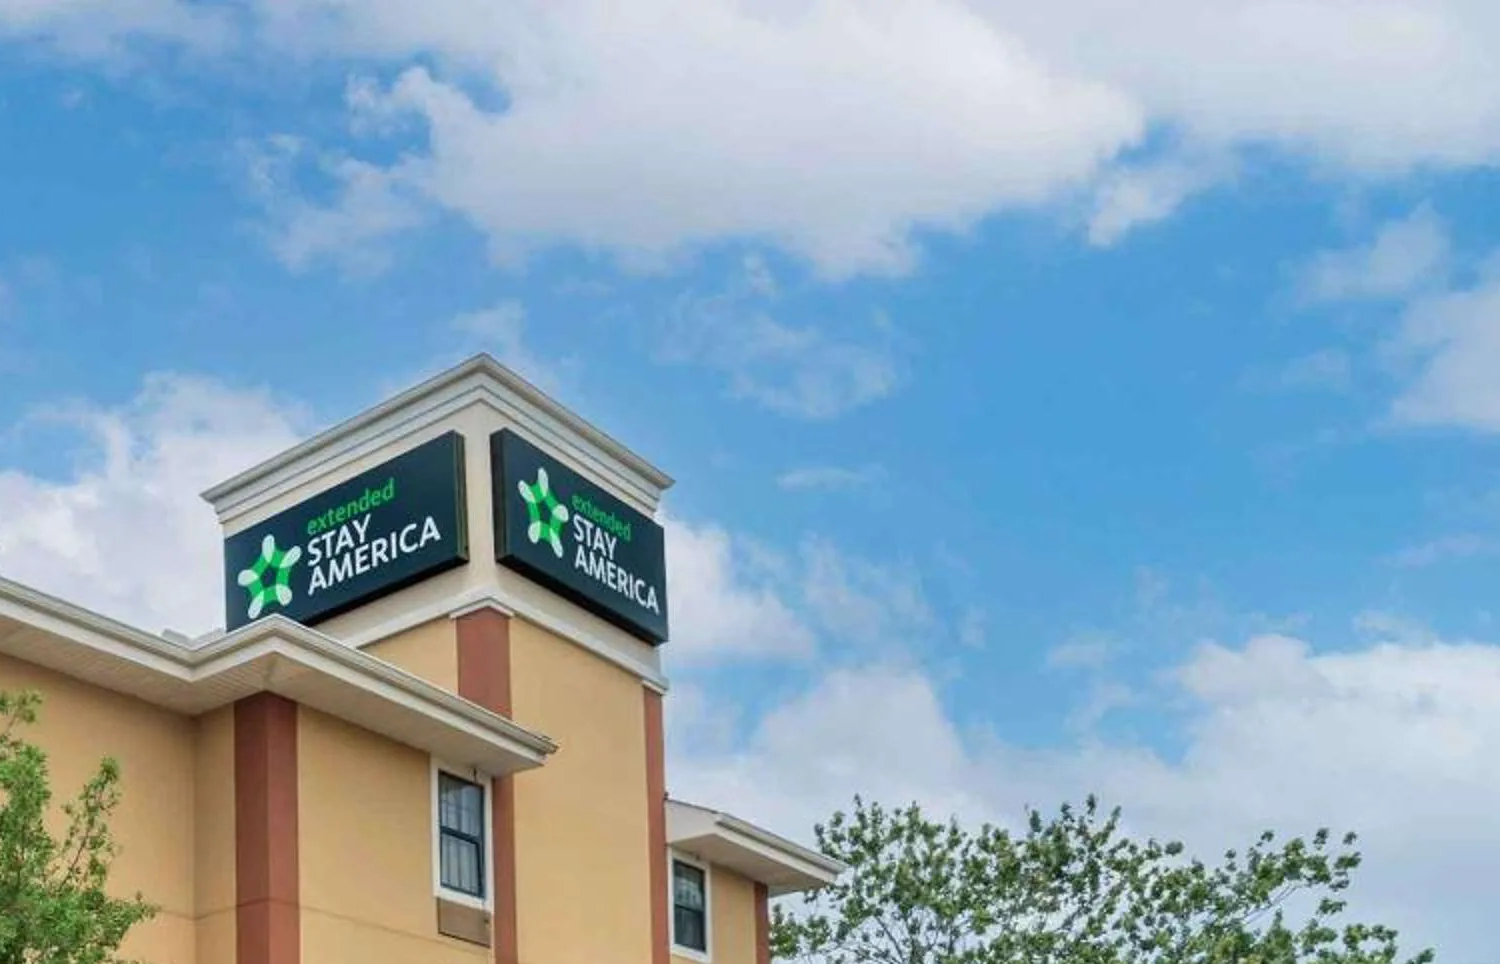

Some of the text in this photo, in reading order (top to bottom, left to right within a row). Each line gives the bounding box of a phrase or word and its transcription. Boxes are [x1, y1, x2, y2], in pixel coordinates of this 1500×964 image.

[307, 477, 395, 535] extended
[572, 495, 631, 541] extended
[307, 513, 371, 566] STAY
[308, 516, 441, 596] AMERICA
[573, 513, 617, 560] STAY
[575, 544, 660, 615] AMERICA
